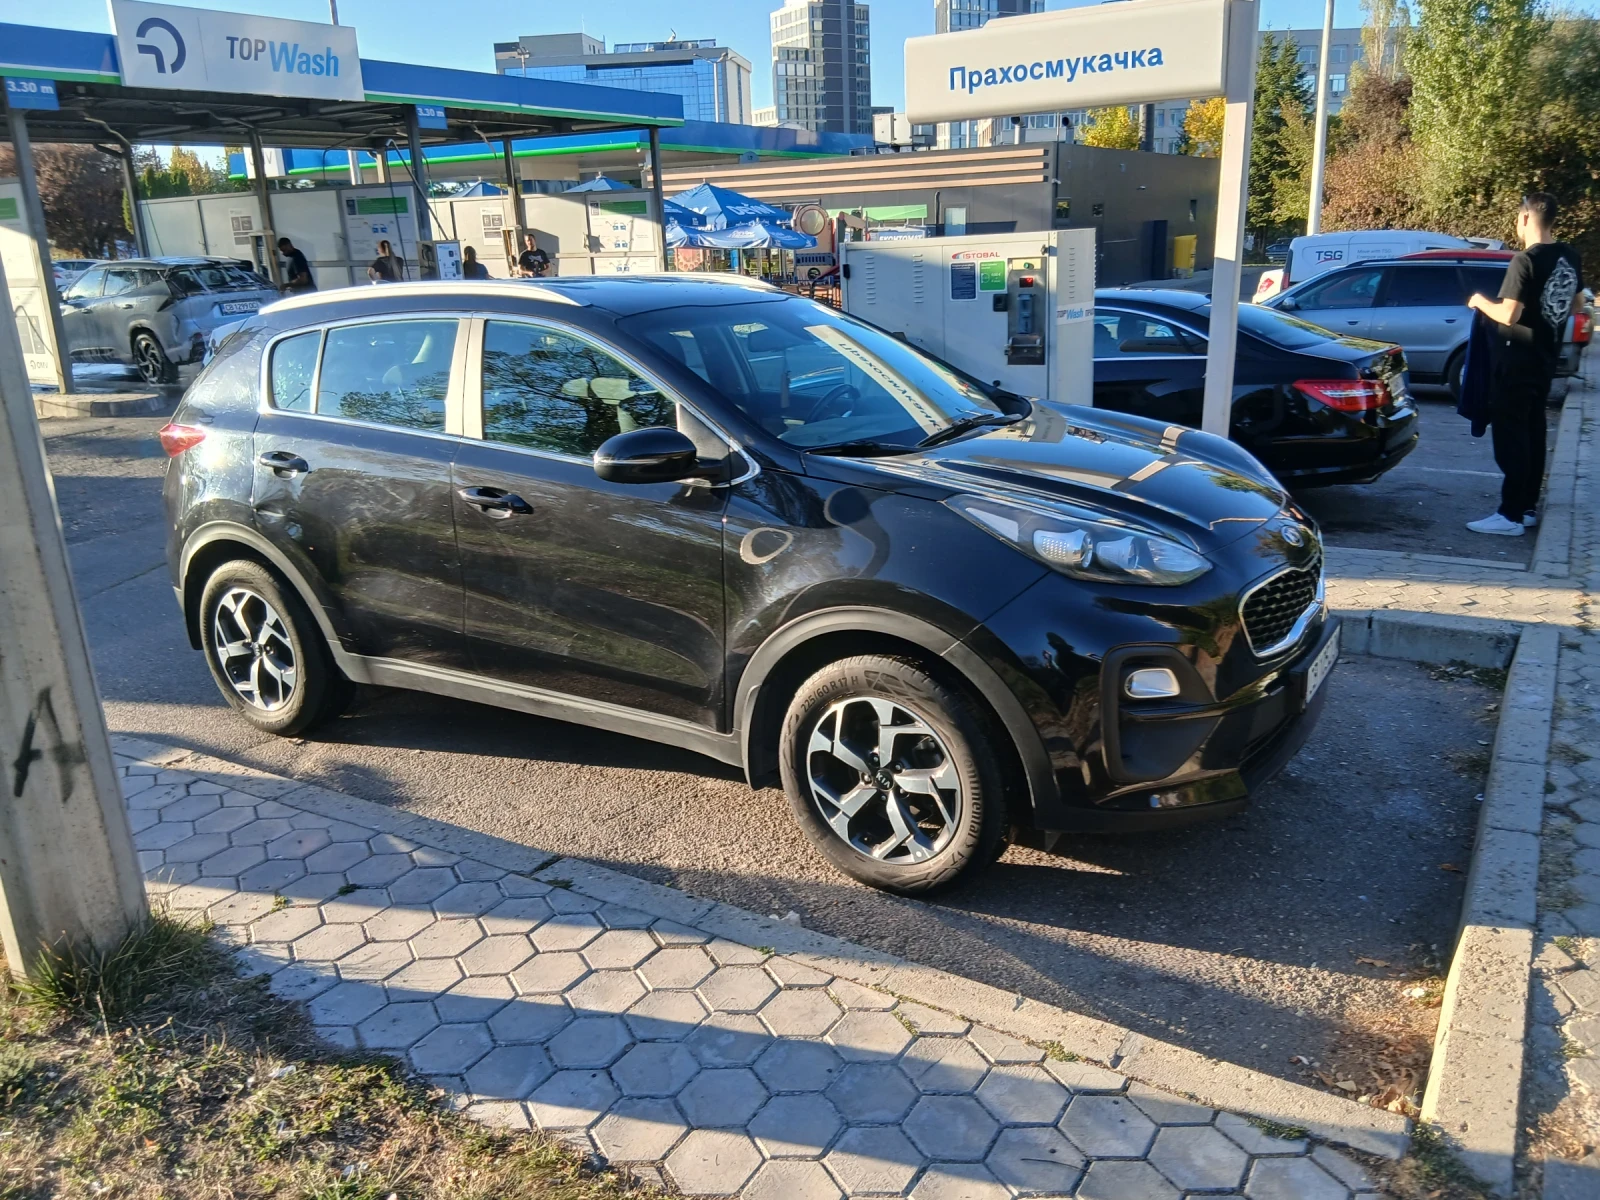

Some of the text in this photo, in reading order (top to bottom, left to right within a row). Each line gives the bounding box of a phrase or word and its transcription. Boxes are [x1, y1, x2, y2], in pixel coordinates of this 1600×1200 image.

[226, 36, 339, 77] TOP Wash
[949, 47, 1164, 94] Прахосмукачка
[6, 80, 55, 95] 3.30 m
[416, 107, 436, 117] 3.30
[962, 251, 1001, 260] ISTOBAL
[1315, 250, 1343, 261] TSG
[1067, 308, 1084, 320] Wash
[801, 675, 859, 713] 225/60 R 17 H
[875, 771, 891, 789] KIA
